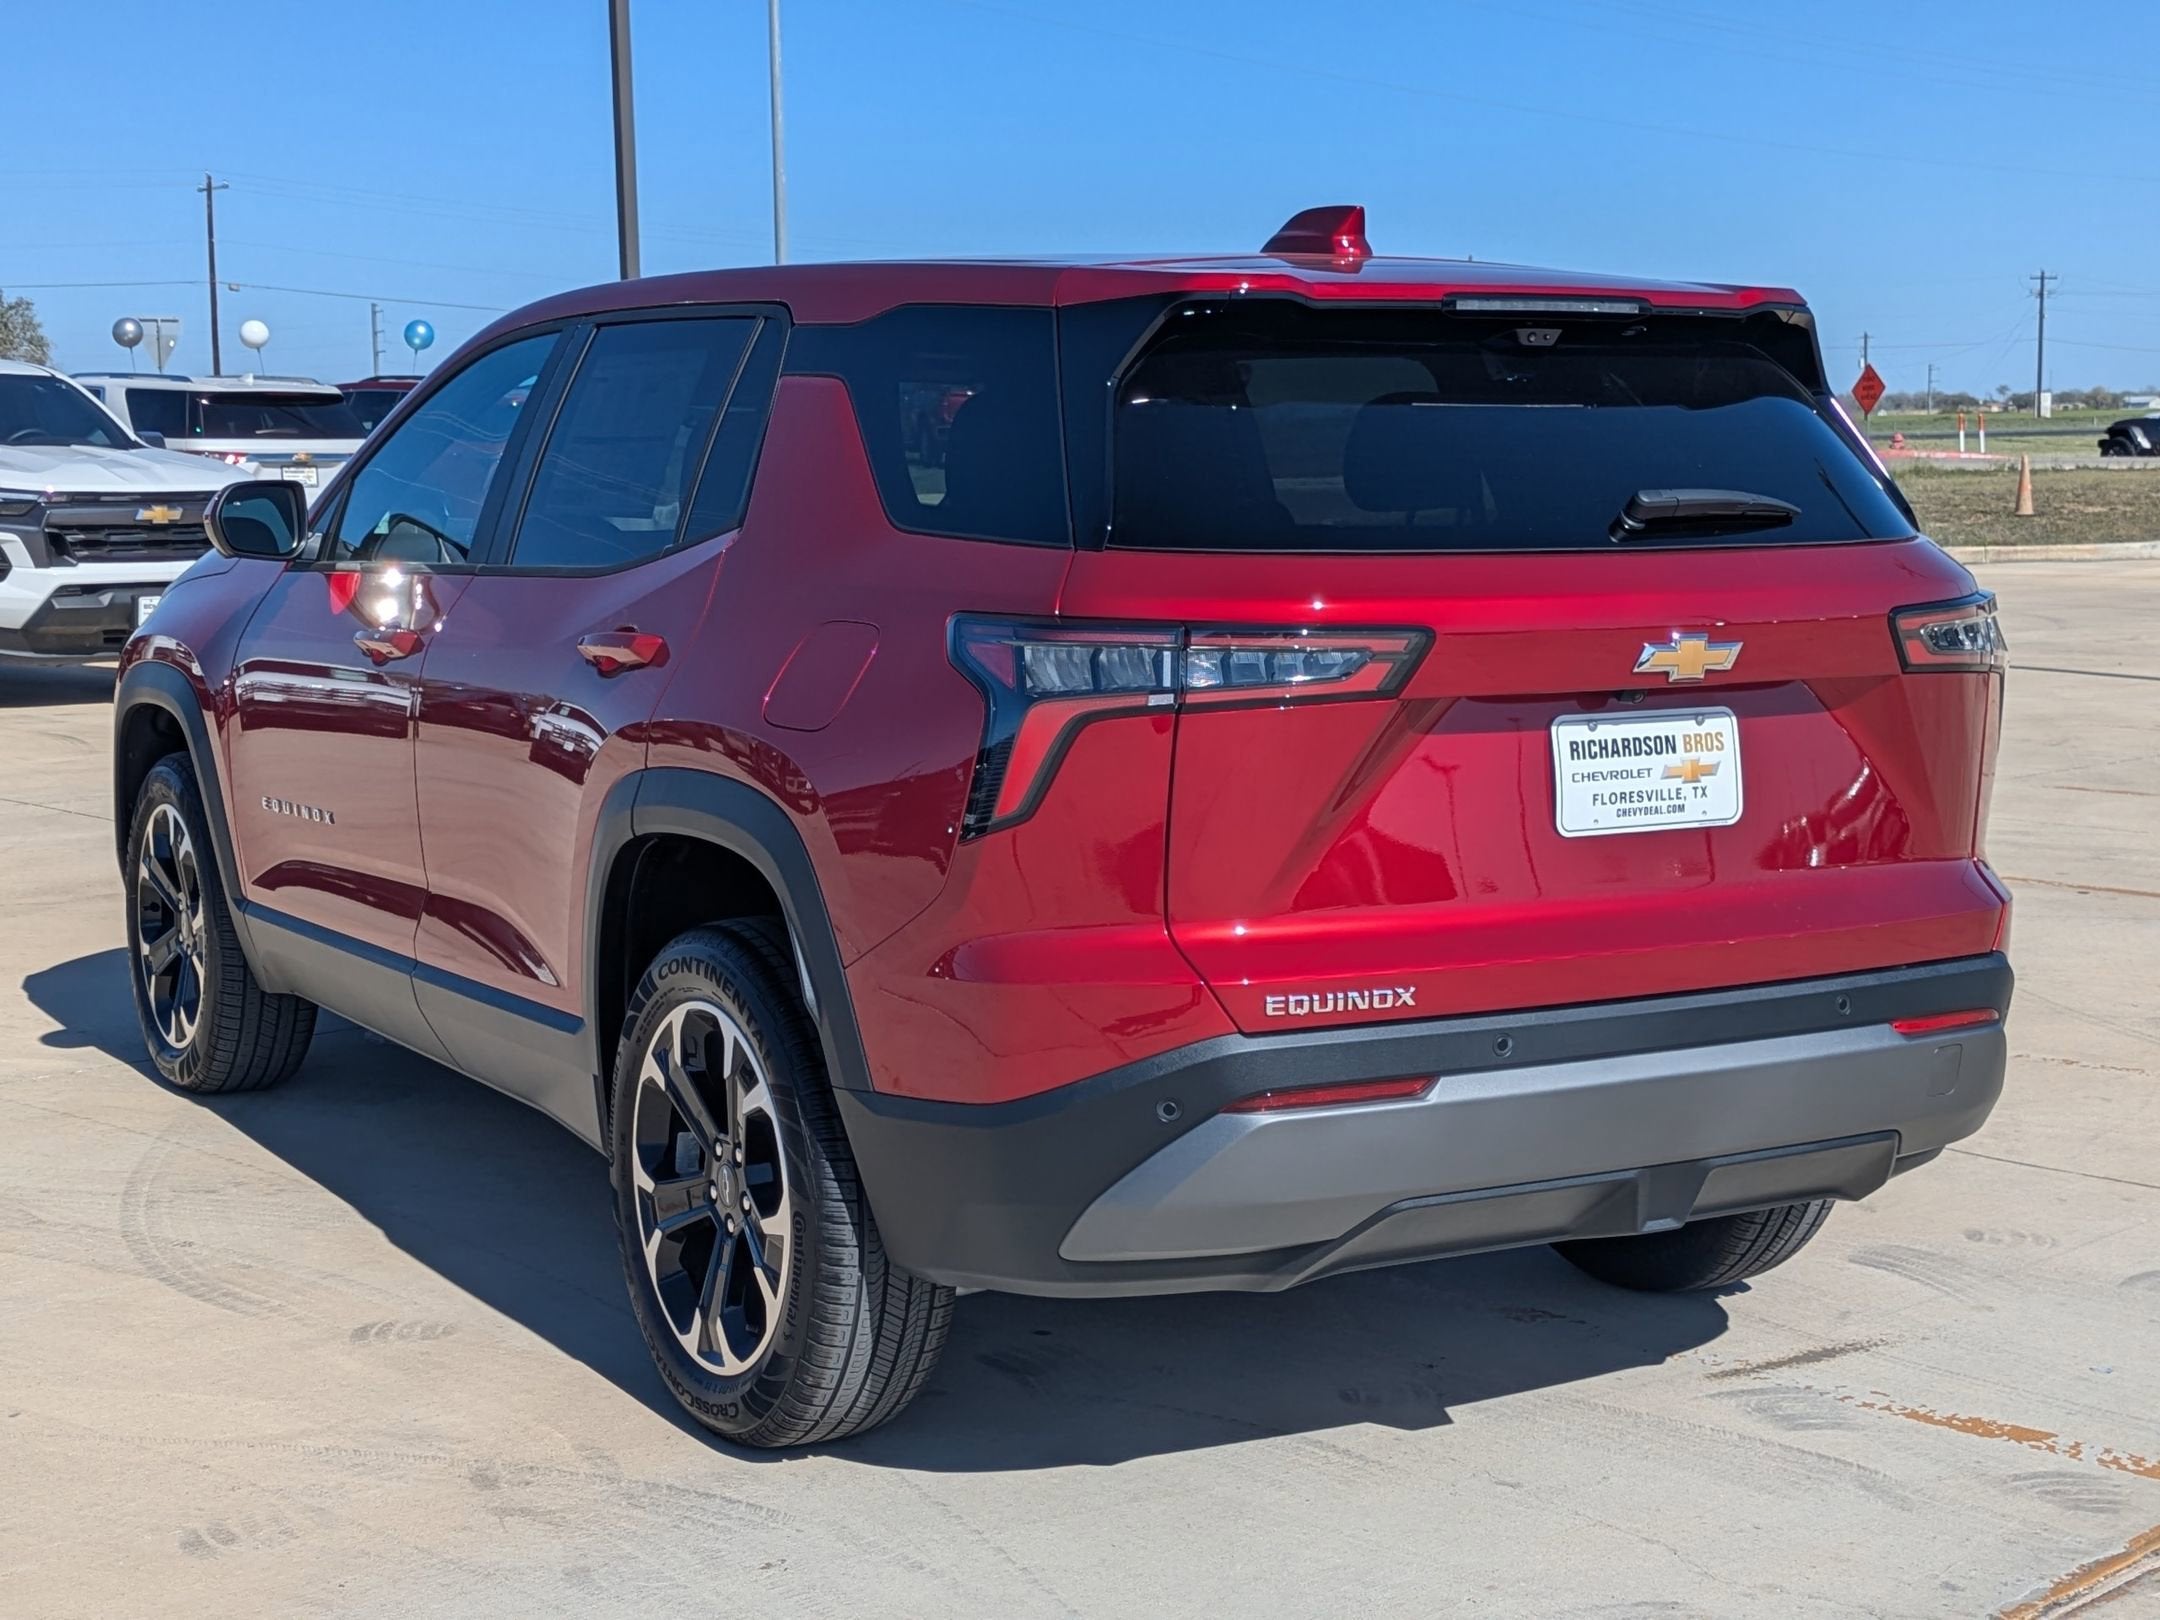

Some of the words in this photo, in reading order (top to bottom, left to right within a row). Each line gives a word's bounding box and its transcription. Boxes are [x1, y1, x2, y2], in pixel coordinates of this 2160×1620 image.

[1569, 734, 1677, 761] RICHARDSON
[1683, 731, 1725, 754] BROS
[1571, 768, 1653, 783] CHEVROLET
[1592, 787, 1687, 807] FLORESVILLE,
[1692, 785, 1708, 799] TX
[261, 795, 335, 825] EQUINOX
[1616, 803, 1685, 818] CHEVYDEAL.COM
[1265, 986, 1416, 1017] EQUINOX
